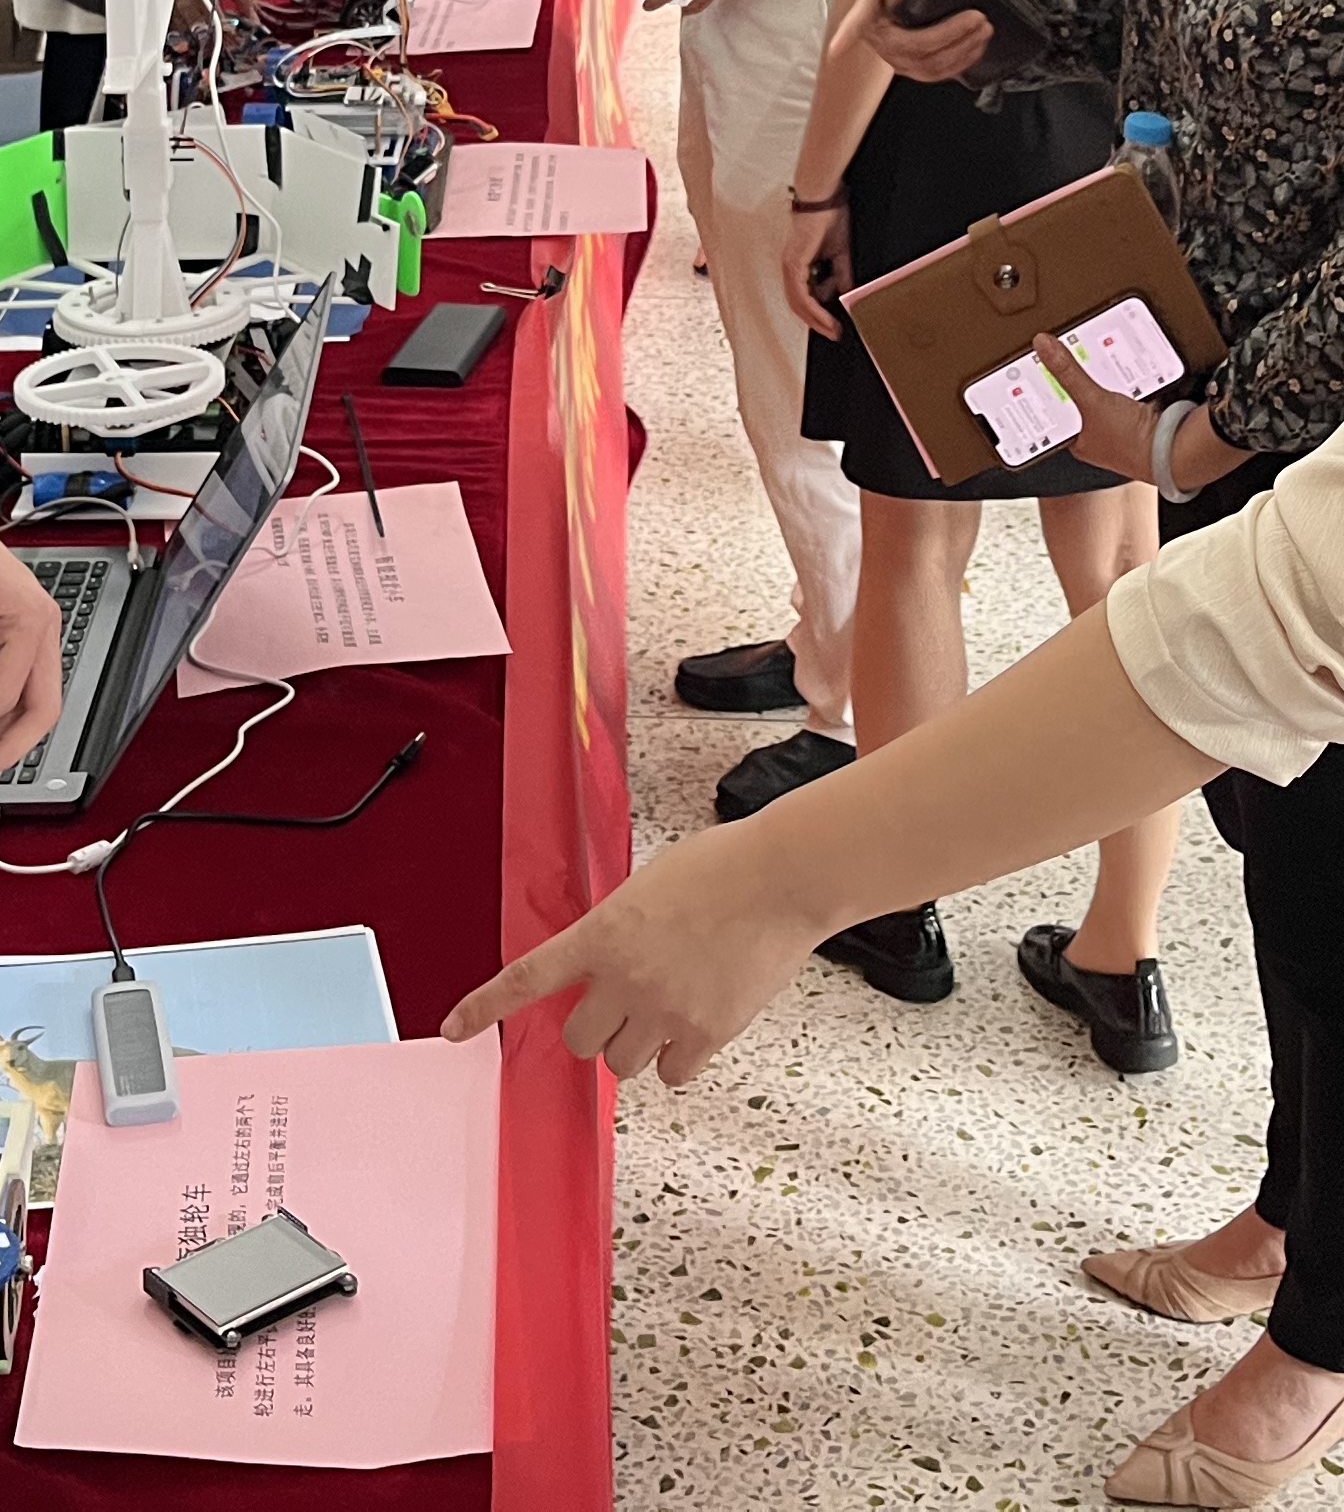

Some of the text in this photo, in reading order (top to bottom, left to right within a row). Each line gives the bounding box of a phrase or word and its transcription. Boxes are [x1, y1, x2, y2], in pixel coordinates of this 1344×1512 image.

[253, 1324, 279, 1418] 轮进行左右平
